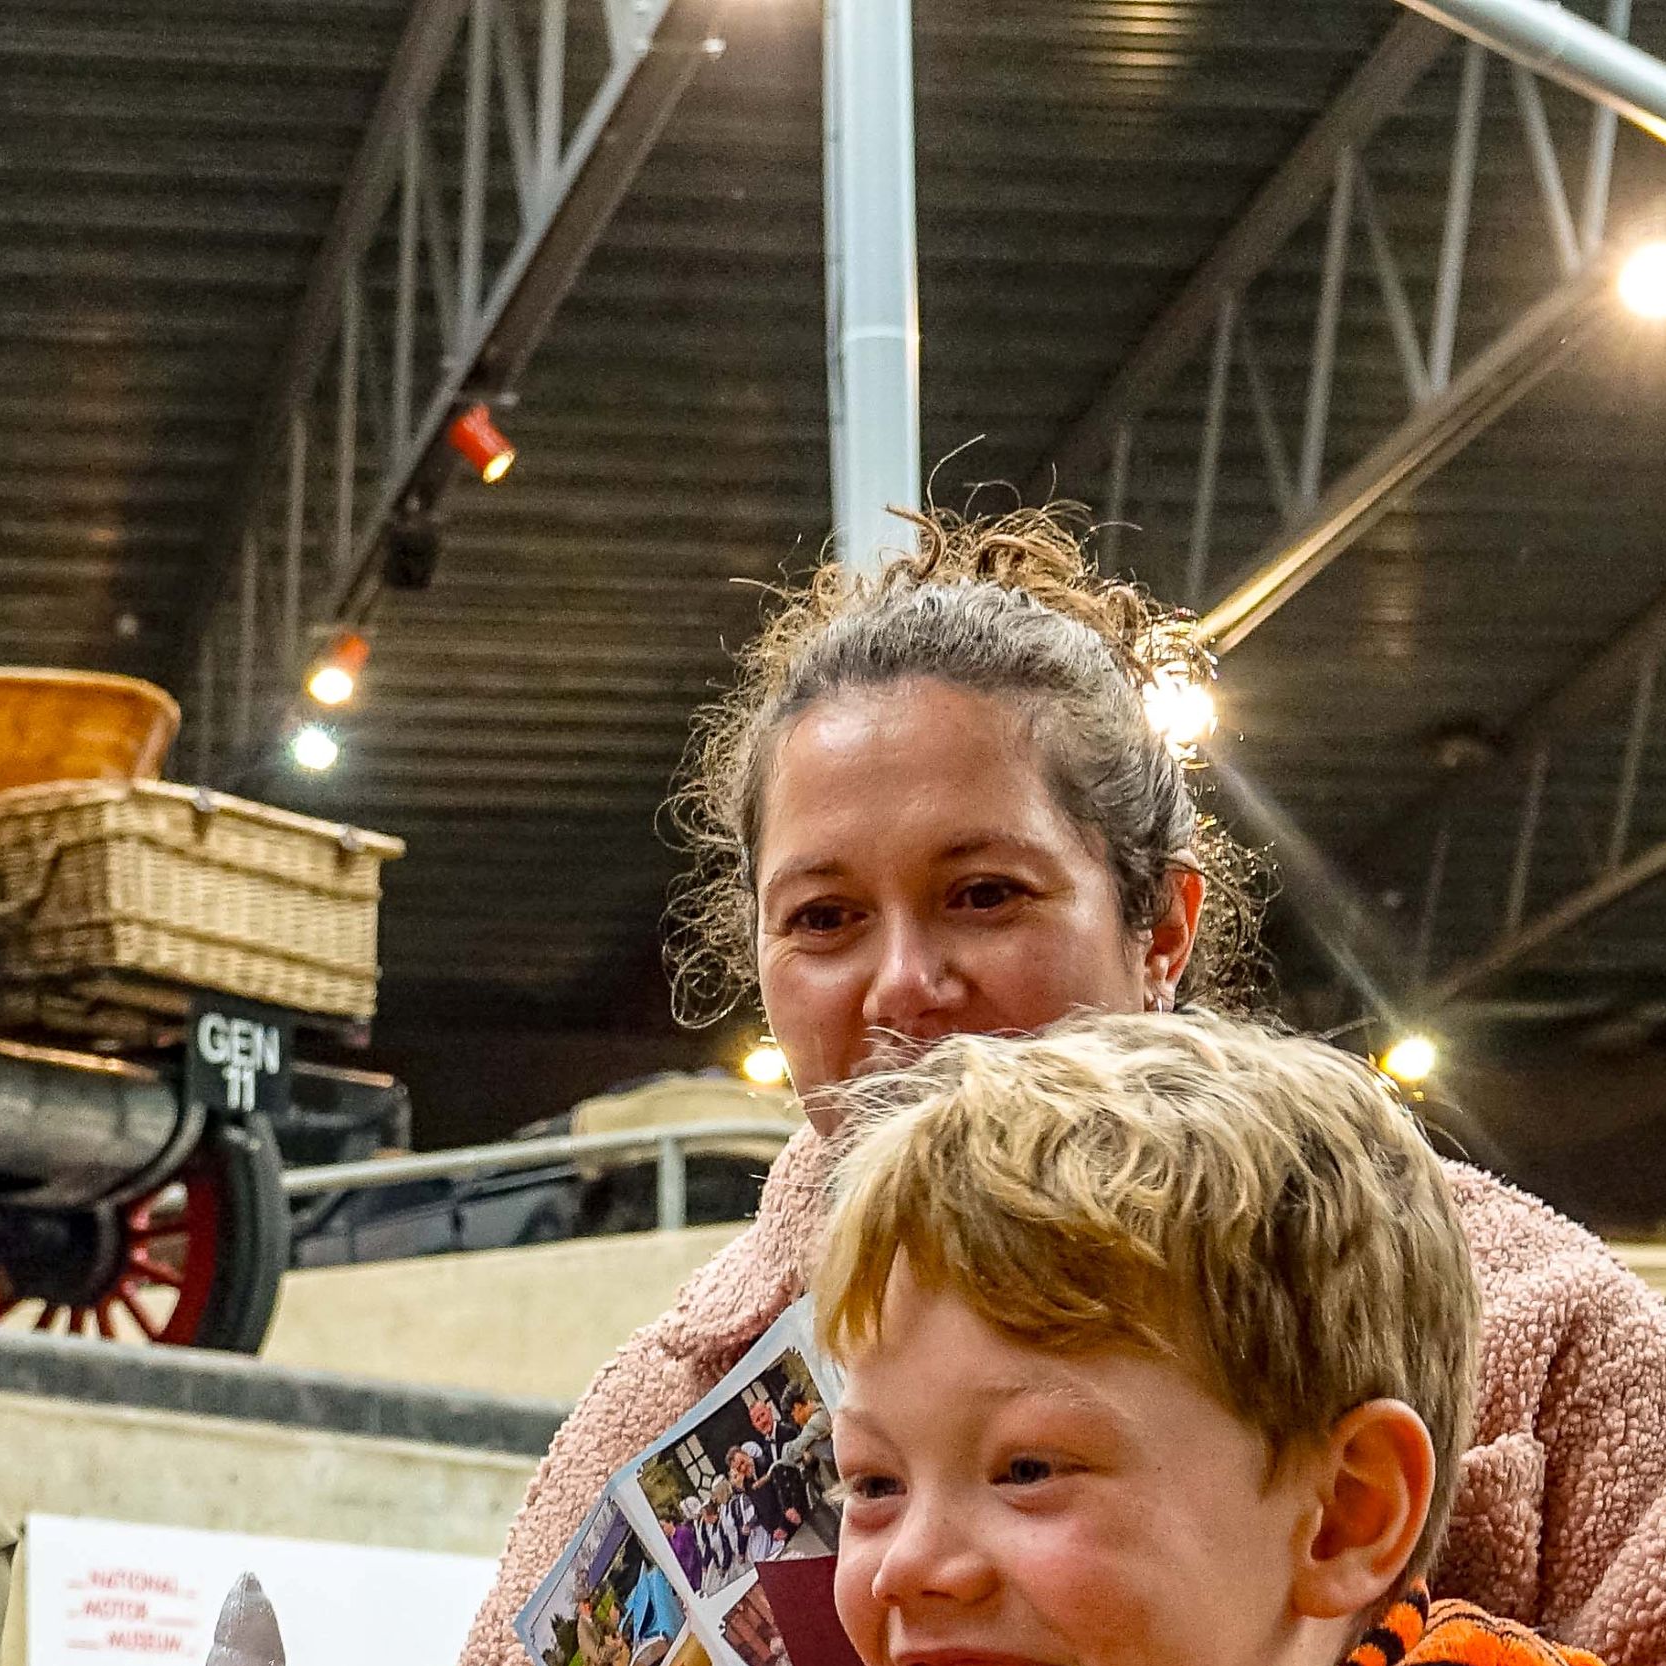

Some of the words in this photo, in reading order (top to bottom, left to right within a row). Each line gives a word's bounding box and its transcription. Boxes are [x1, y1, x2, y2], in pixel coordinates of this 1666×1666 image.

[198, 1012, 280, 1075] GEN
[222, 1068, 256, 1111] 11
[89, 1570, 178, 1596] NATIONAL
[84, 1600, 149, 1620] MOTOR
[108, 1631, 182, 1653] MUSEUM
